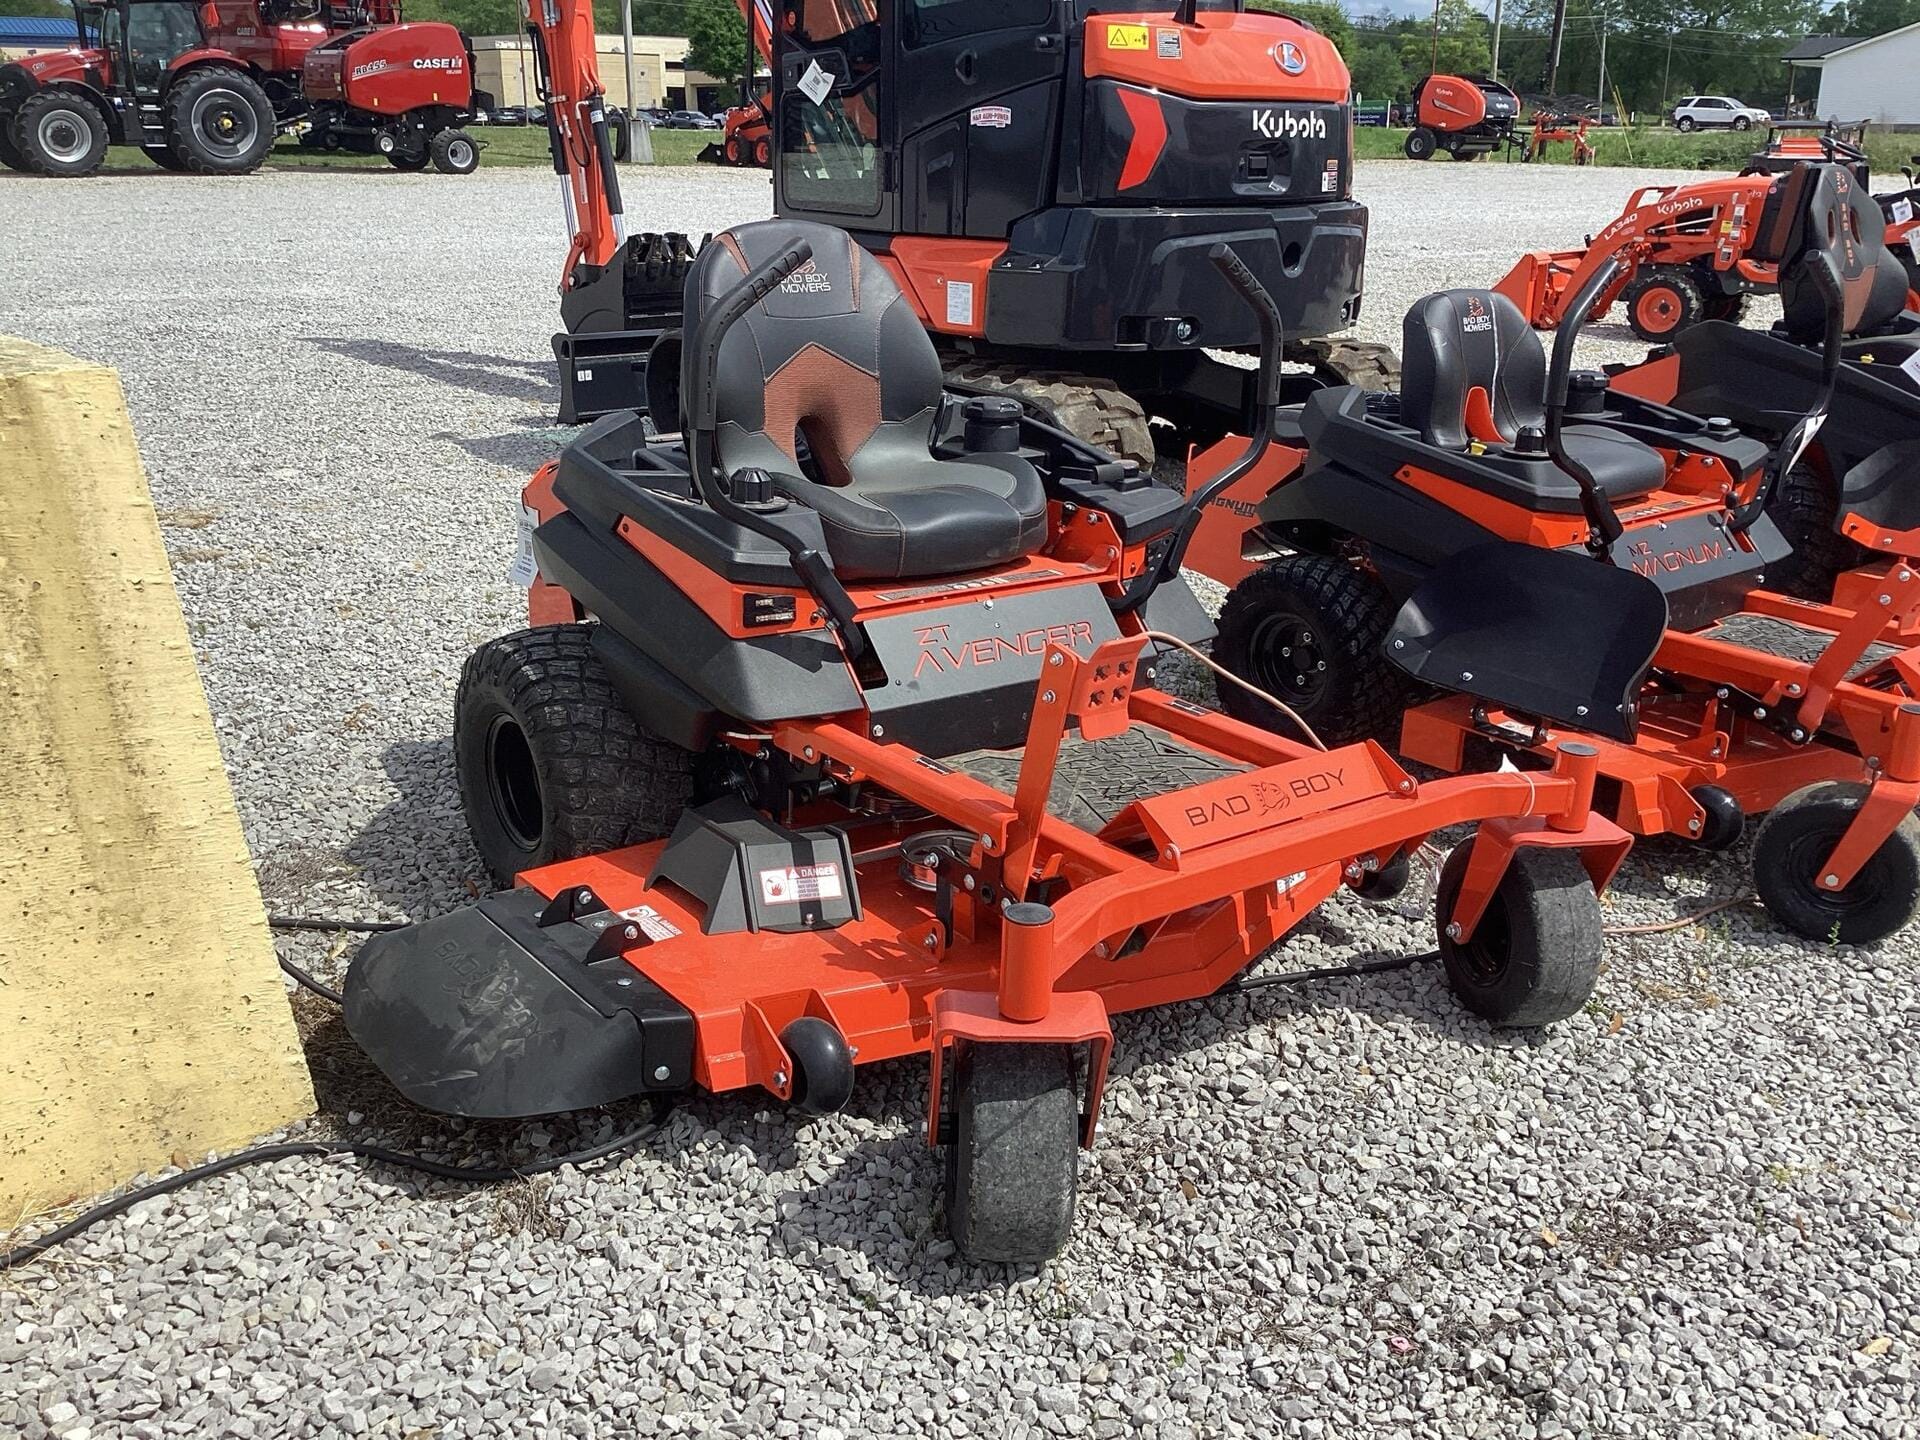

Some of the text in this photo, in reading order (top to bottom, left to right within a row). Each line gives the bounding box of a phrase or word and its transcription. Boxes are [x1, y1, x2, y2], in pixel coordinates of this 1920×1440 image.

[355, 60, 387, 76] RB455
[413, 58, 450, 69] CASE
[1252, 109, 1326, 139] Kubota
[1657, 197, 1703, 215] Kubota
[1604, 212, 1638, 241] LA340
[805, 273, 828, 283] BOY
[780, 281, 832, 294] MOWERS
[1462, 314, 1491, 325] BAD BOY
[1463, 321, 1492, 332] MOWERS
[1627, 541, 1653, 557] MZ
[1632, 541, 1724, 578] MAGNUM
[912, 624, 950, 646] ZT
[914, 621, 1094, 678] AVENGER
[1184, 768, 1344, 827] BAD BOY
[801, 867, 835, 877] DANGER
